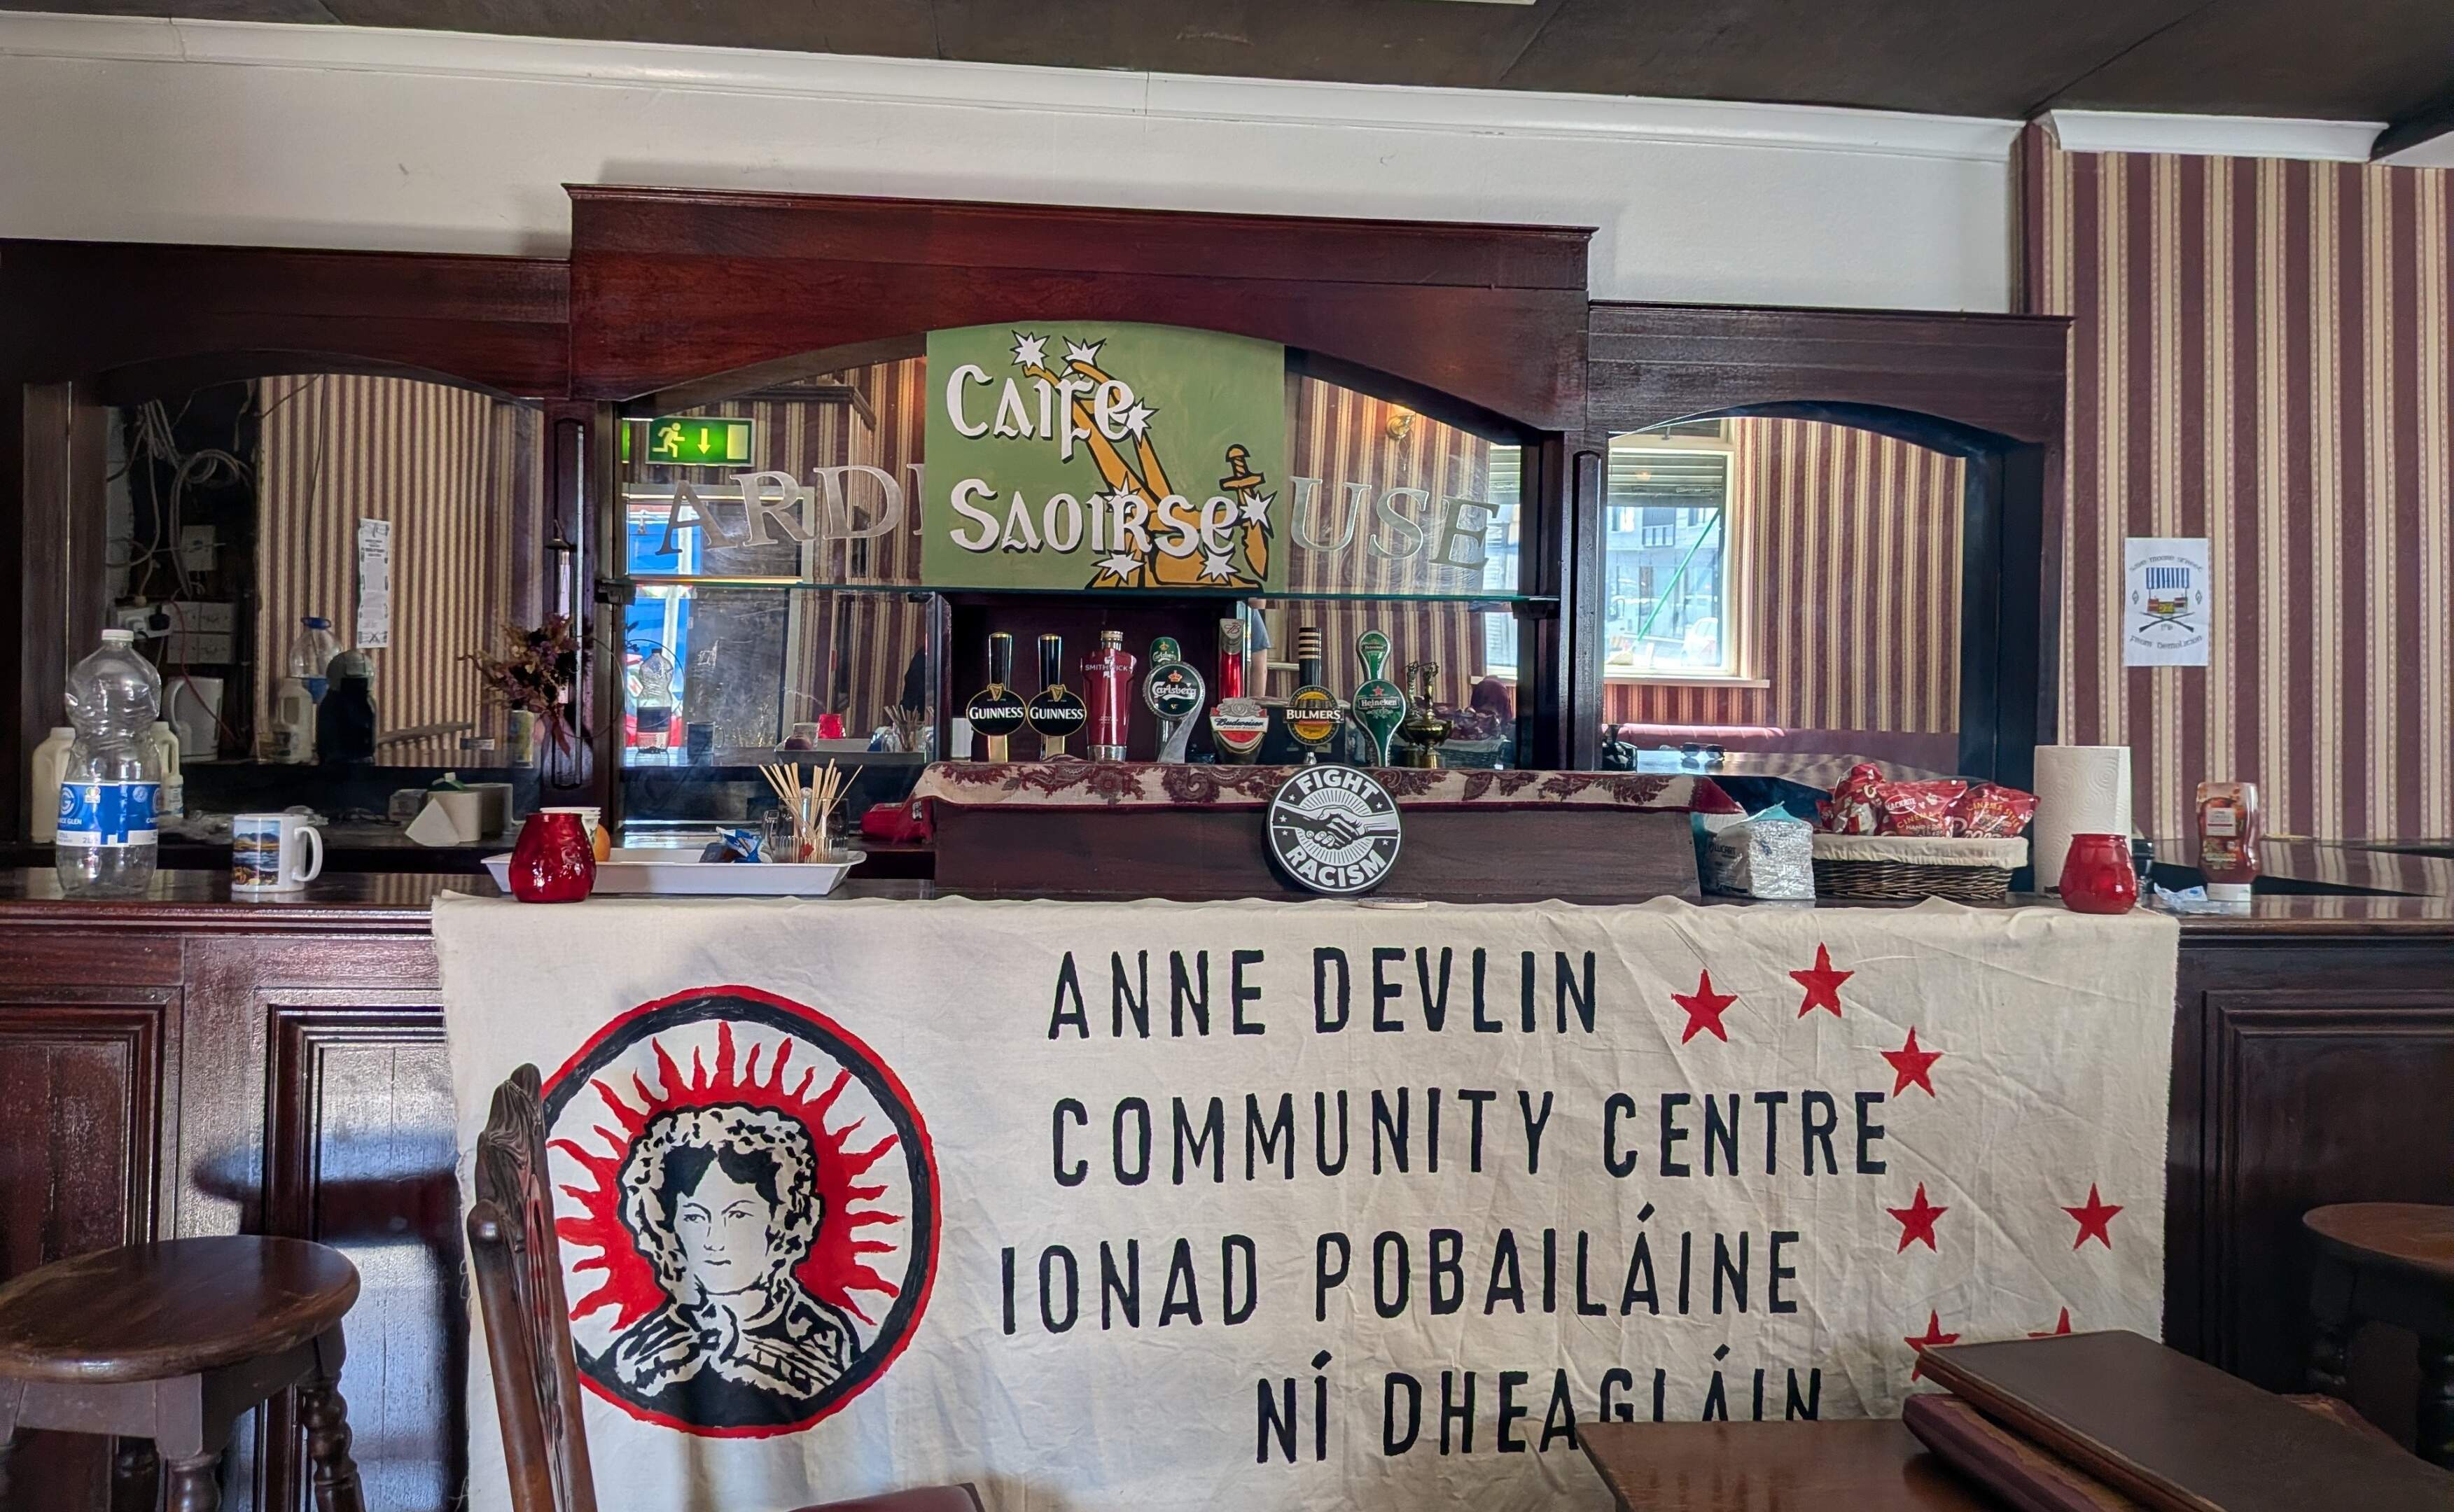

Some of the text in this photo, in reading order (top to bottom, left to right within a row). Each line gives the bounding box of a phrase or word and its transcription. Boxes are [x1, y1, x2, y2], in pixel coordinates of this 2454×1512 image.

[1152, 681, 1197, 700] Carlsberg
[1361, 698, 1398, 707] Heineken
[969, 706, 1024, 720] GUINNESS
[1029, 706, 1085, 720] GUINNESS
[1215, 718, 1264, 727] Budweiser
[1286, 709, 1341, 720] BULMERS
[1295, 769, 1379, 800] FIGHT
[1285, 849, 1387, 887] RACISM
[1047, 946, 1596, 1040] ANNE DEVLIN
[1052, 1086, 1888, 1187] COMMUNITY CENTRE
[1001, 1233, 1258, 1336] IONAD
[1255, 1349, 1333, 1464] NÍ
